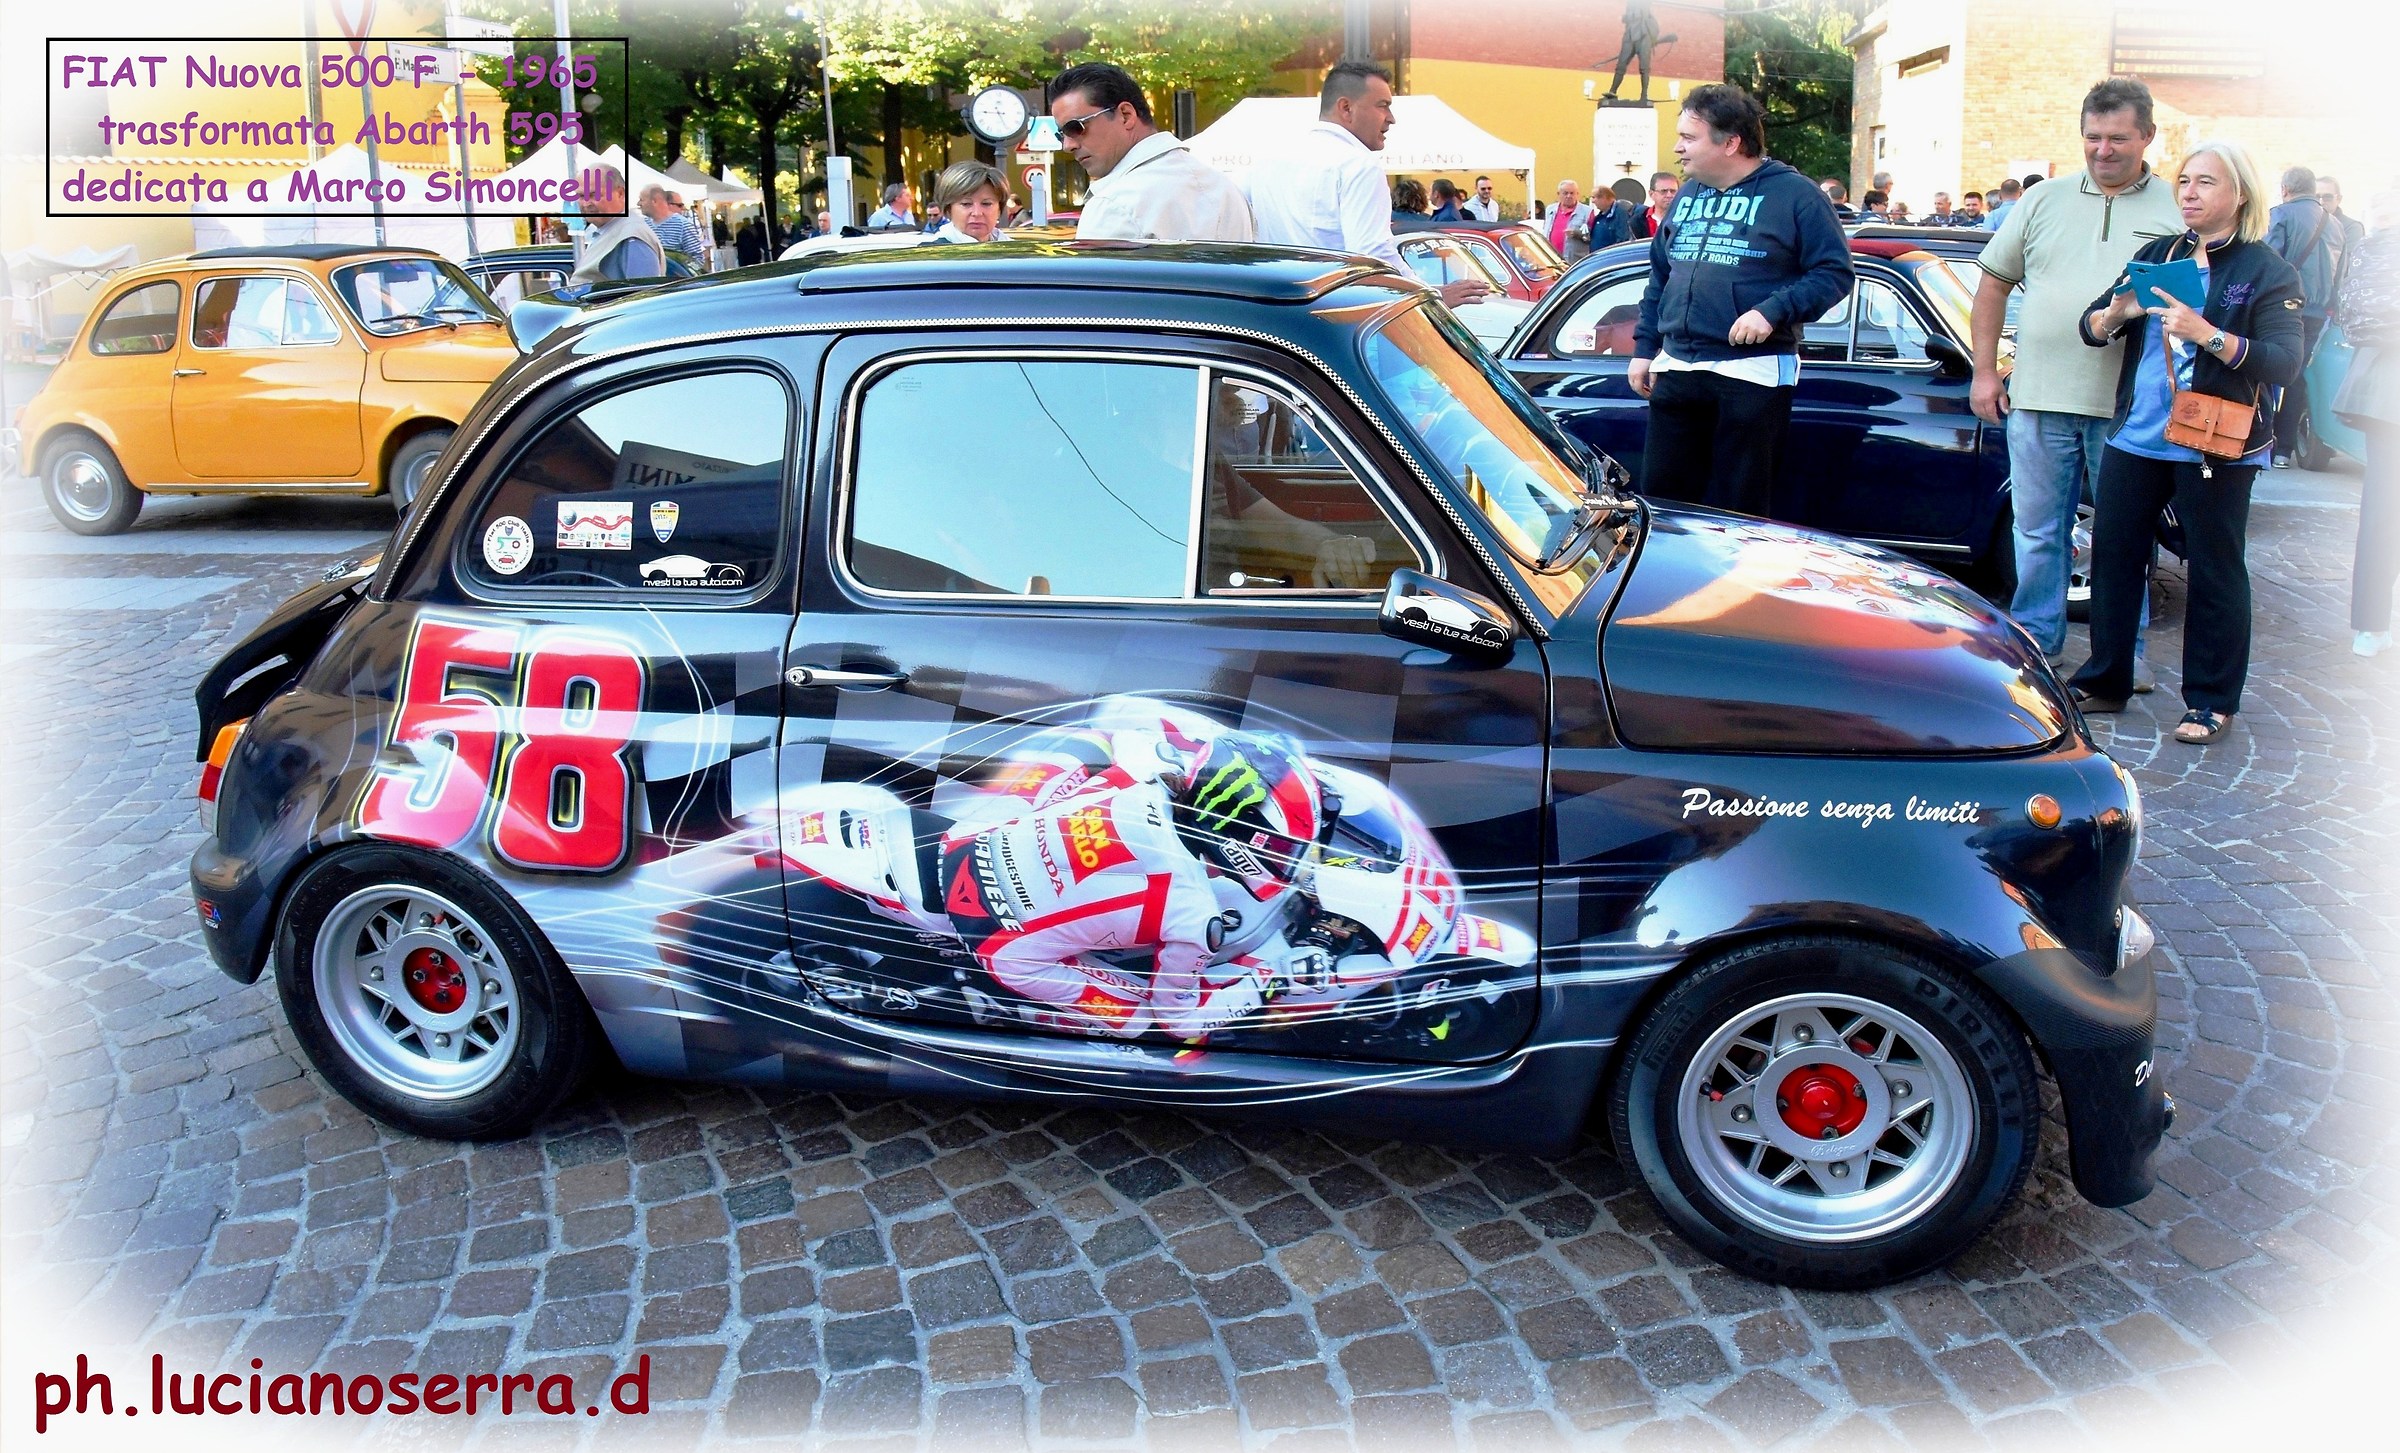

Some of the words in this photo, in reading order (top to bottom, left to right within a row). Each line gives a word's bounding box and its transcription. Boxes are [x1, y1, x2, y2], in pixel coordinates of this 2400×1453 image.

[1672, 195, 1765, 226] GAUDI
[1708, 252, 1740, 266] ROADS
[672, 578, 682, 587] la
[683, 578, 698, 587] tua
[699, 578, 743, 587] auto.com
[1430, 622, 1442, 634] la
[1443, 626, 1461, 639] tua
[355, 611, 645, 873] 58
[1681, 787, 1809, 819] Passione
[1820, 799, 1895, 829] senza
[1905, 795, 1981, 824] limiti
[1035, 817, 1065, 898] HONDA
[1914, 976, 2021, 1126] PIRELLI
